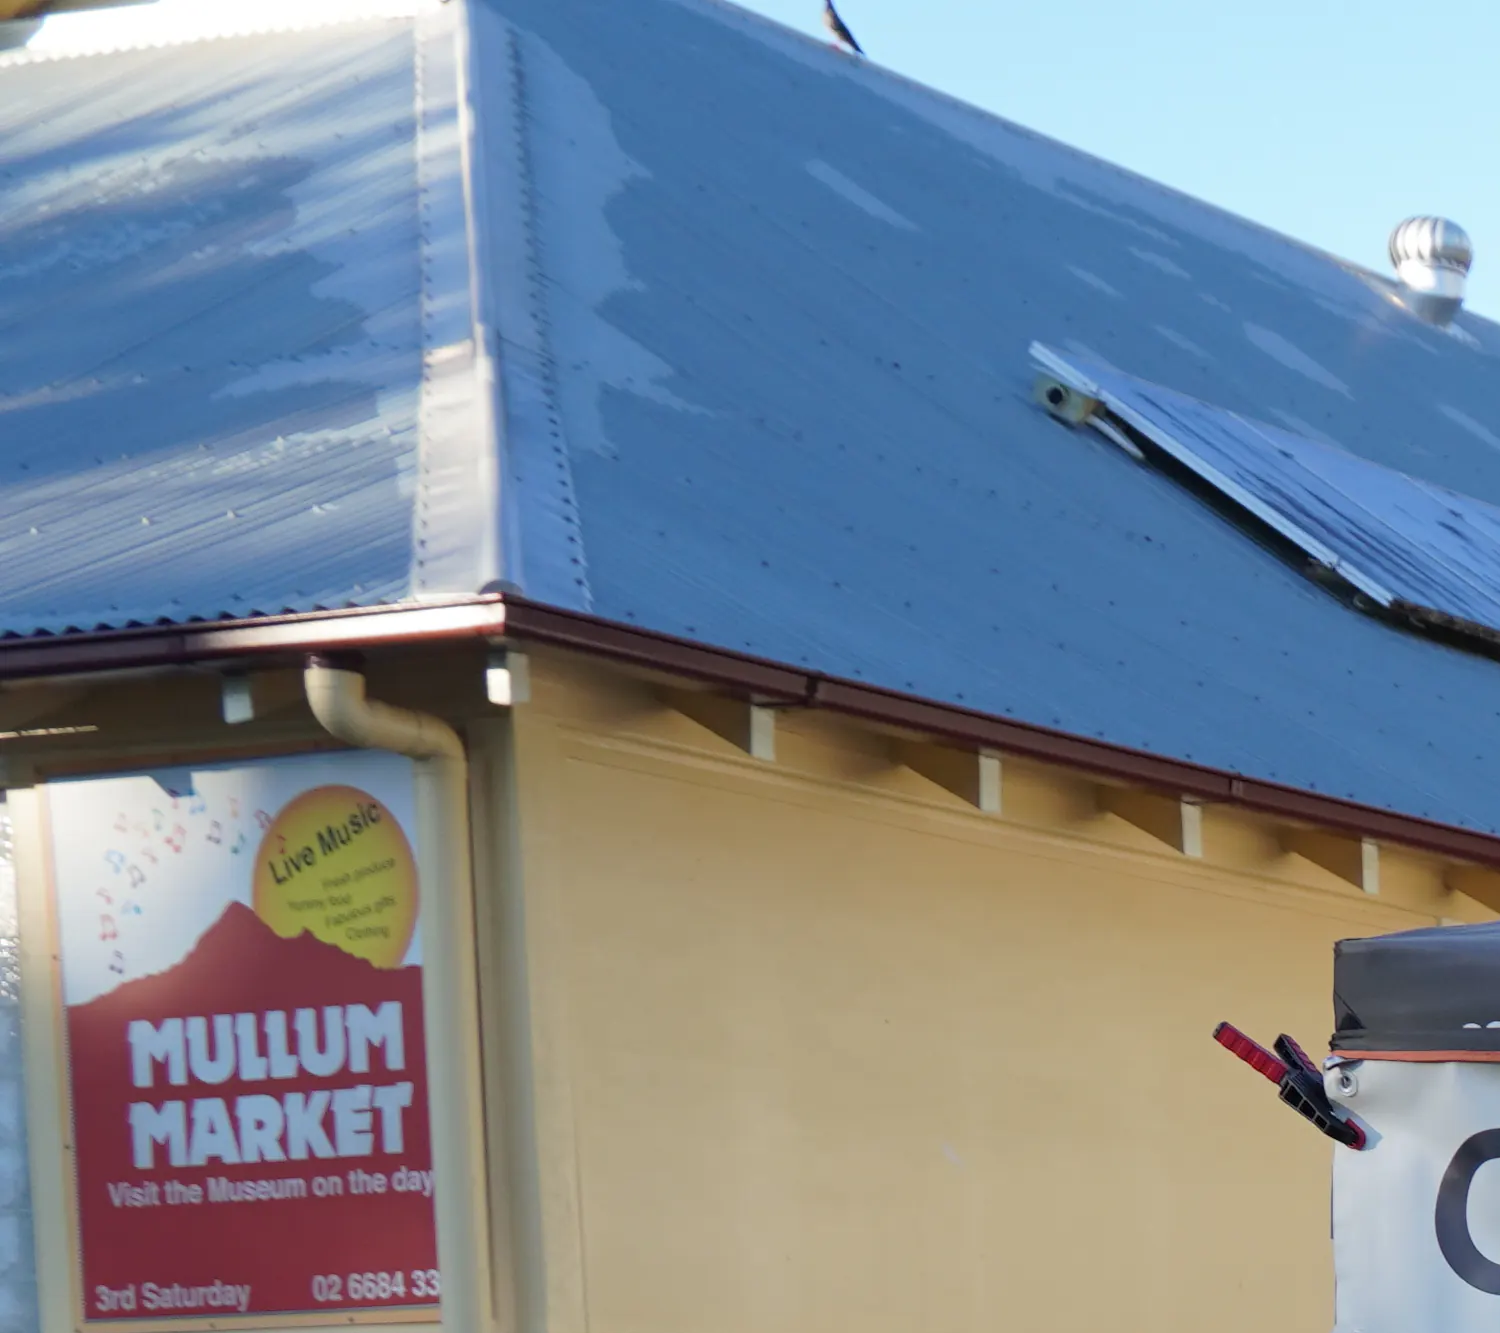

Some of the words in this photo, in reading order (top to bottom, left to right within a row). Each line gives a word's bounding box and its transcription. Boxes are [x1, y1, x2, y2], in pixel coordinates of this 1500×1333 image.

[268, 846, 315, 885] Live
[316, 802, 381, 856] Music
[128, 1001, 405, 1088] MULLUM
[128, 1082, 413, 1169] MARKET
[107, 1182, 160, 1208] Visit
[164, 1180, 202, 1205] the
[206, 1176, 306, 1203] Museum
[312, 1174, 343, 1197] on
[347, 1169, 387, 1195] the
[392, 1166, 436, 1197] day
[95, 1284, 137, 1312] 3rd
[141, 1279, 250, 1312] Saturday
[312, 1274, 342, 1302] 02
[348, 1271, 405, 1299] 6684
